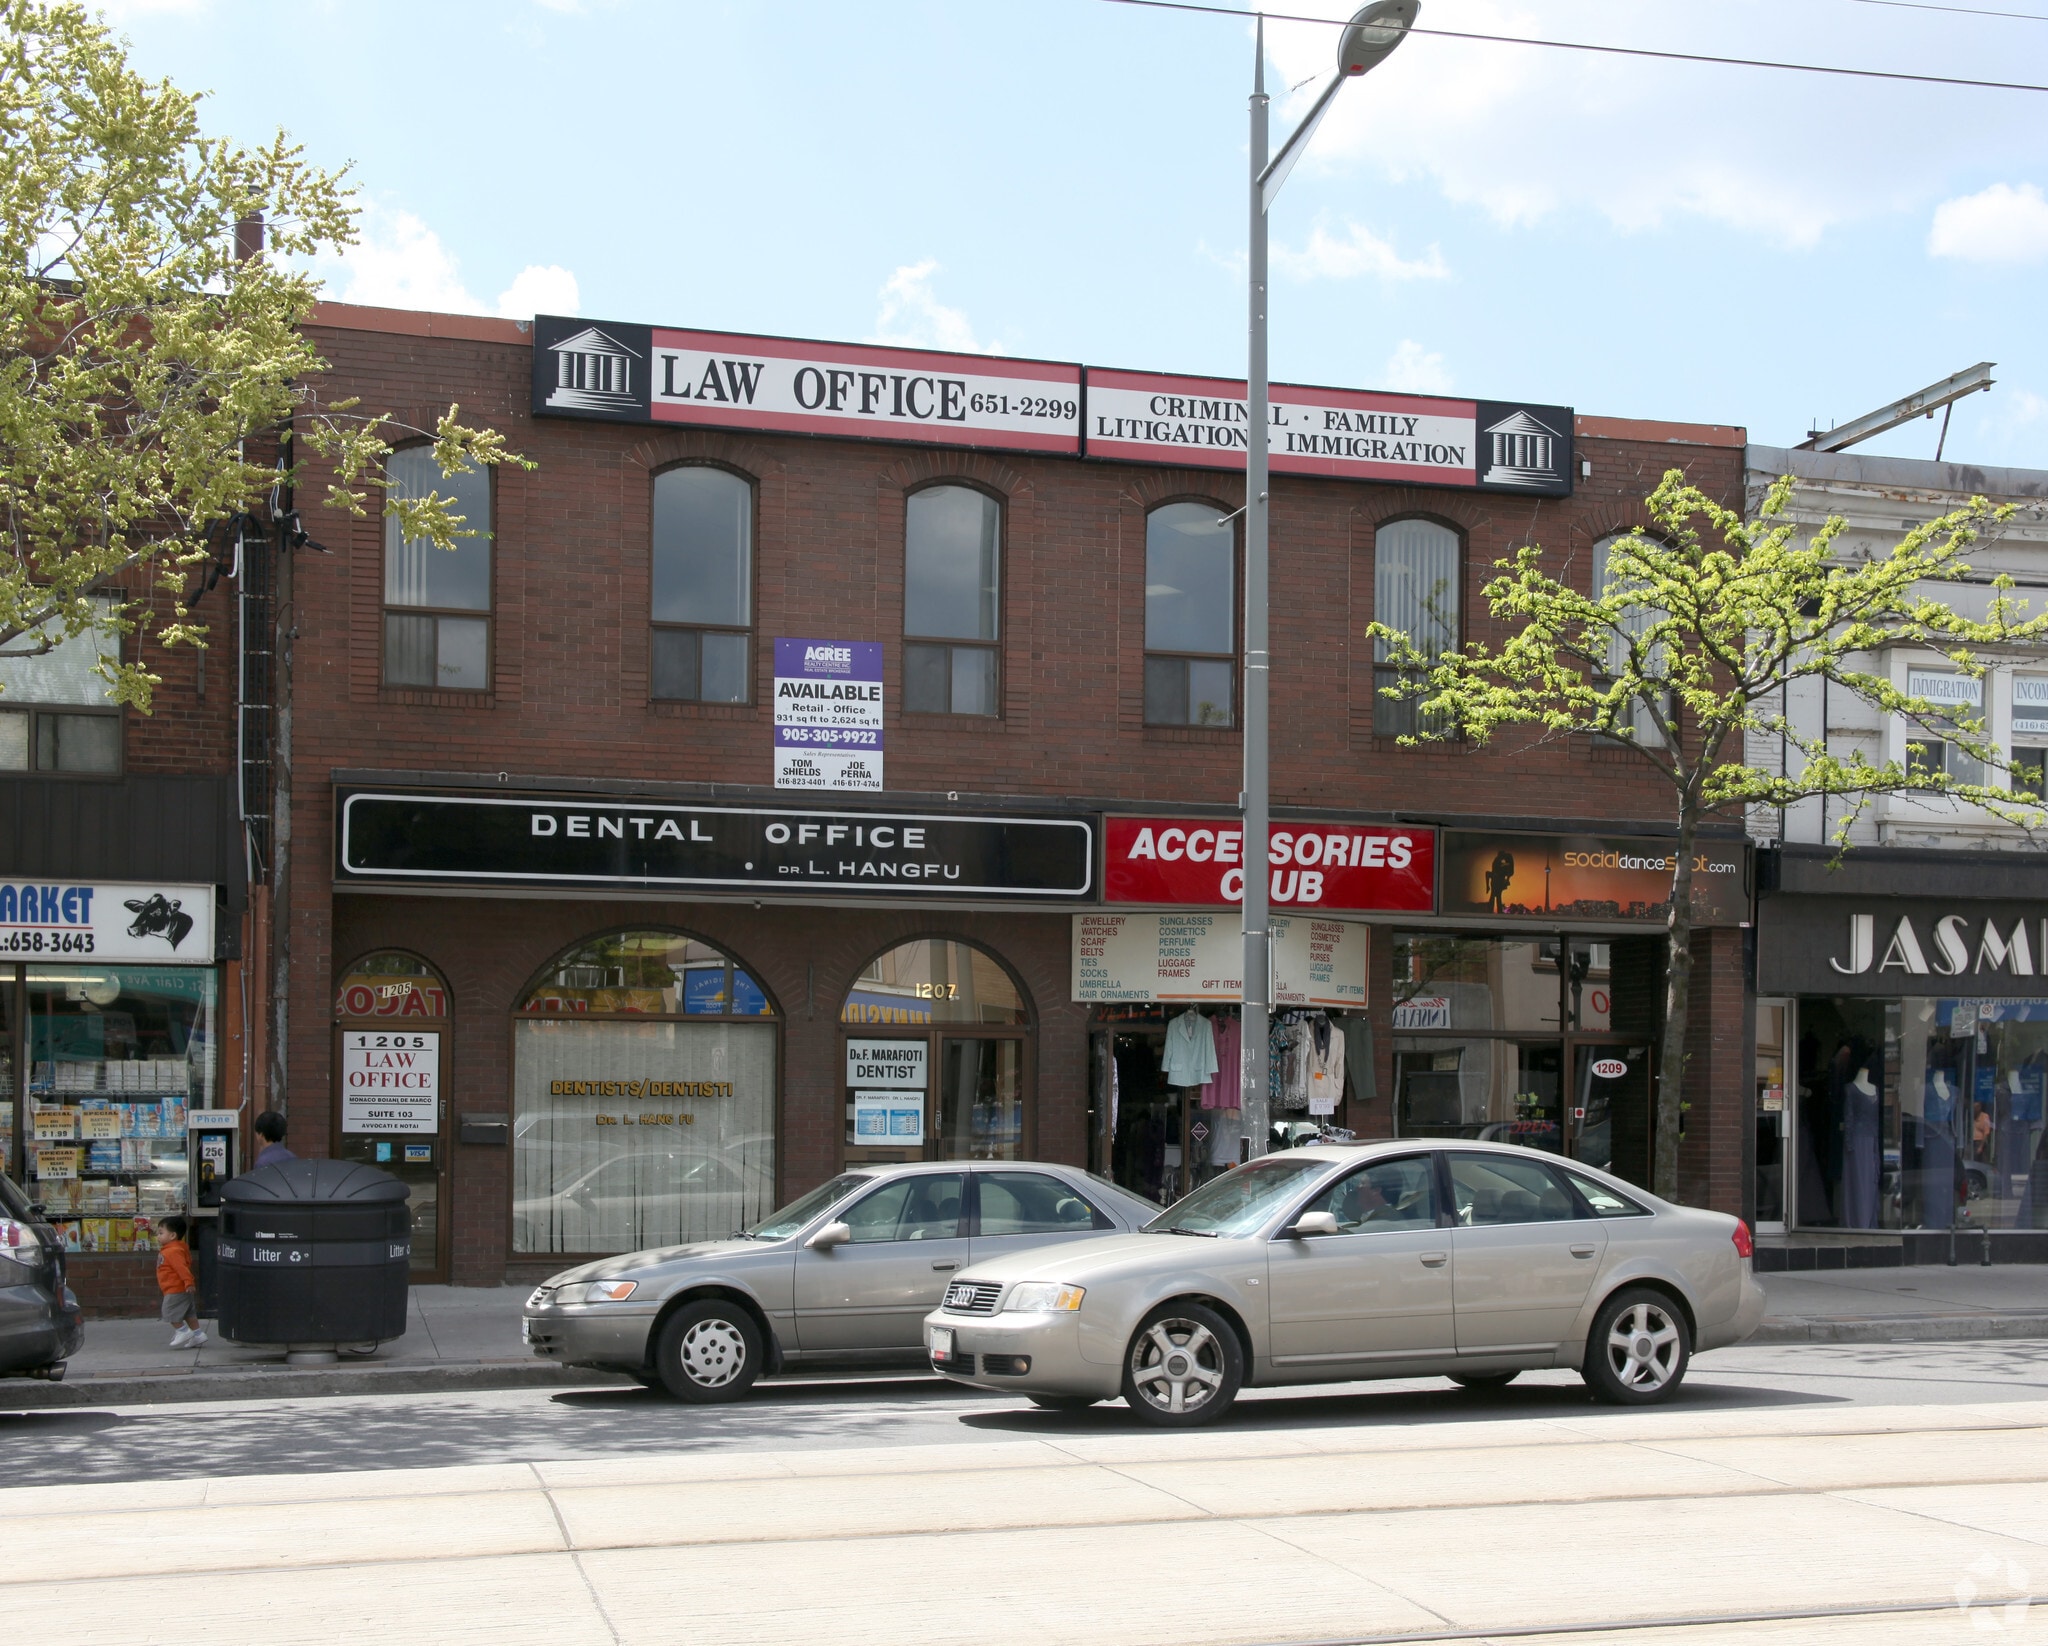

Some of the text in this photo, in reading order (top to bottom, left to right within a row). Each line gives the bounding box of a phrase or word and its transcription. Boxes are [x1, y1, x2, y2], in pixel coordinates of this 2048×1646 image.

[659, 354, 1077, 421] LAW OFFICE 651-2299
[1149, 396, 1420, 437] CRIMINL FAMILY
[1097, 416, 1466, 466] LITIGATION IMMIGRATION
[804, 646, 851, 662] AGREE
[778, 683, 881, 702] AVAILABLE
[1912, 678, 1979, 700] IMMIGRATION
[792, 703, 824, 713] Retail
[833, 705, 866, 715] Office
[810, 715, 817, 723] ft
[791, 759, 812, 767] TOM
[847, 761, 865, 769] JOE
[782, 767, 821, 776] SHIELDS
[841, 770, 872, 778] PERNA
[531, 814, 926, 849] DENTAL OFFICE
[1127, 828, 1413, 869] ACCESORIES
[1564, 850, 1736, 873] socialdancesot.com
[778, 860, 961, 879] DR. L. HANGFU
[1220, 868, 1324, 902] CUB
[1080, 917, 1126, 926] JEWELLERY
[1159, 917, 1213, 926] SUNGLASSES
[1081, 927, 1118, 936] WATCHES
[1159, 927, 1206, 936] COSMETICS
[1310, 922, 1345, 933] SUNGLASSES
[1080, 938, 1107, 946] SCARF
[1159, 938, 1196, 946] PERFUME
[1310, 932, 1340, 943] COSMETICS
[1080, 948, 1104, 956] BELTS
[1159, 948, 1190, 957] PURSES
[1310, 943, 1334, 952] PERFUME
[1080, 958, 1098, 967] TIES
[1158, 959, 1195, 967] LUGGAGE
[1310, 953, 1330, 962] PURSES
[1310, 963, 1334, 972] LUGGAGE
[1080, 969, 1108, 978] SOCKS
[1158, 969, 1190, 978] FRAMES
[1309, 973, 1330, 982] FRAMES
[1079, 980, 1121, 988] UMBRELLA
[1202, 980, 1242, 988] GIFT ITEM
[1337, 984, 1364, 995] GIFT ITEMS
[383, 983, 411, 997] 1205
[915, 983, 957, 999] 1207
[1079, 991, 1149, 999] HAIR ORNAMENTS
[357, 1036, 424, 1048] 1205
[365, 1052, 416, 1068] LAW
[872, 1049, 922, 1061] MARAFIOTI
[857, 1065, 916, 1078] DENTIST
[1596, 1063, 1622, 1074] 1209
[349, 1071, 432, 1088] OFFICE
[639, 1114, 673, 1125] HANG
[679, 1114, 694, 1125] FU
[1509, 1120, 1554, 1134] OPEN
[222, 1244, 236, 1258] Litter
[253, 1247, 282, 1262] Litter
[390, 1245, 404, 1258] Litter
